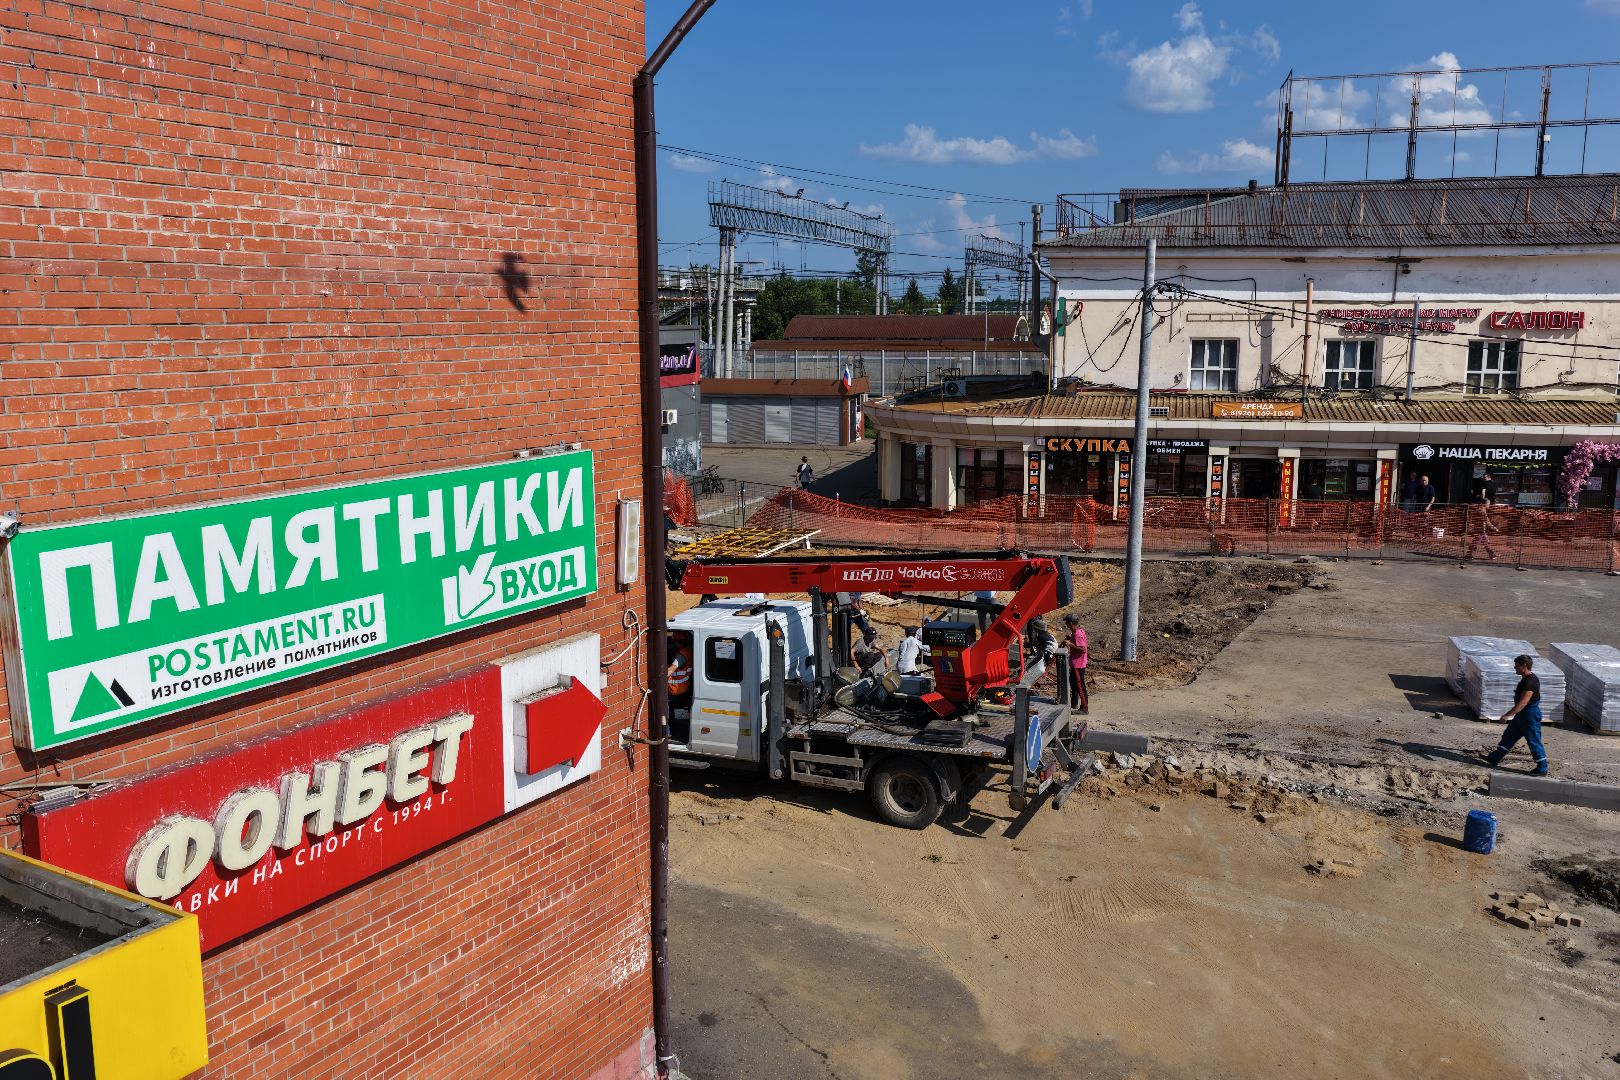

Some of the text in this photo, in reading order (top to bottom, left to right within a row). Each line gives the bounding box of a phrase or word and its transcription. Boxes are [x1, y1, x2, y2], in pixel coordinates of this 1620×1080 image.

[1489, 310, 1585, 330] САЛОН
[1240, 403, 1275, 411] АРЕНДА
[1047, 438, 1130, 453] СКУПКА
[1439, 447, 1548, 460] НАША ПЕКАРНЯ
[39, 466, 584, 641] ПАМЯТНИКИ
[501, 553, 578, 605] ВХОД
[898, 566, 941, 580] Чайка
[148, 602, 376, 683] POSTAMENT.RU
[151, 631, 378, 700] изготовление памятников
[127, 713, 474, 901] ФОНБЕТ
[253, 860, 283, 886] НА
[295, 824, 366, 866] СПОРТ
[373, 817, 384, 832] С
[392, 799, 433, 825] 1994
